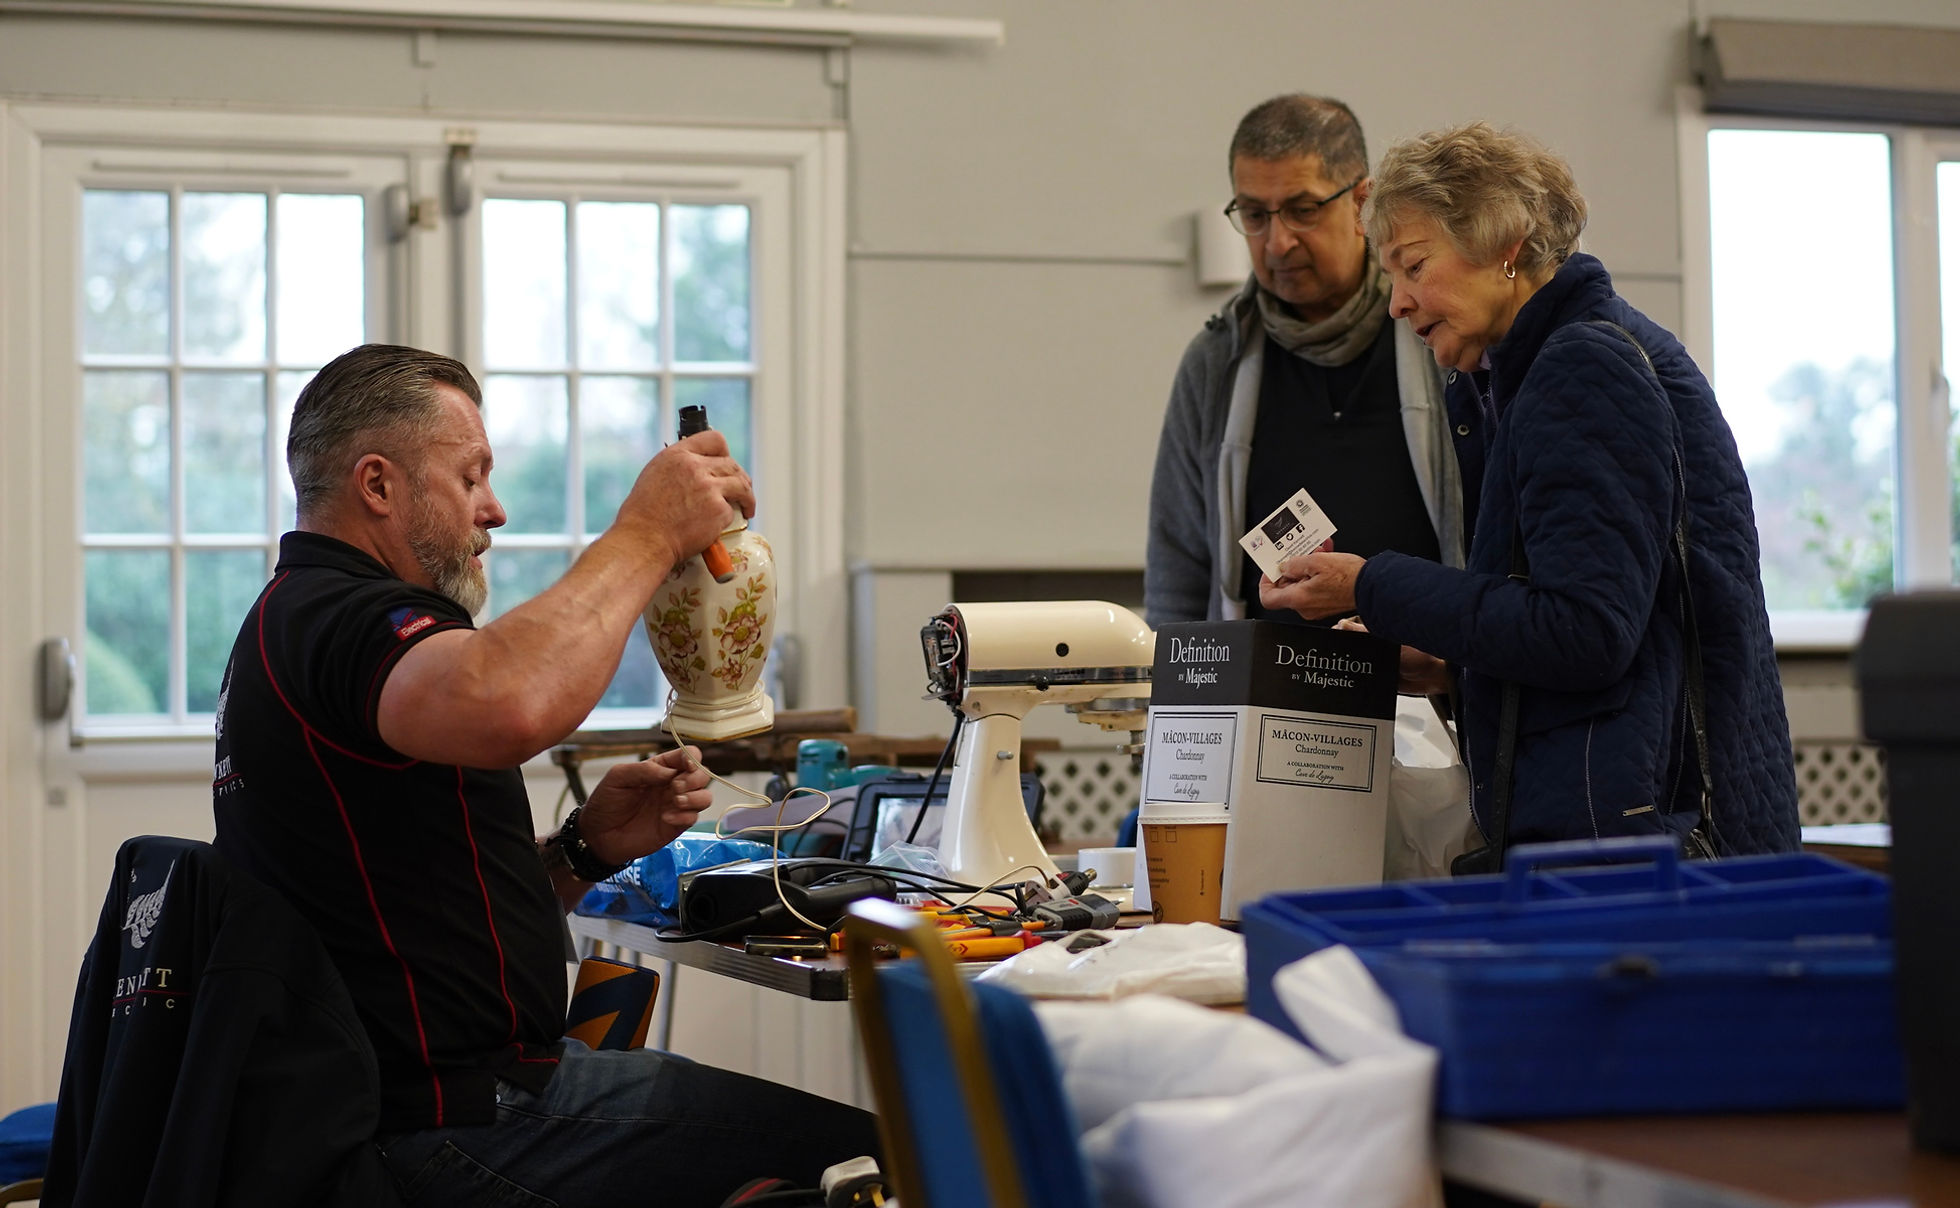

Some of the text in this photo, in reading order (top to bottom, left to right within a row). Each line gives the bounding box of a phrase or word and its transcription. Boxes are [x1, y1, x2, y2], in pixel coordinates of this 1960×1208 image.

[1169, 636, 1230, 664] Definition
[1275, 644, 1373, 674] Definition
[1178, 667, 1218, 689] BY Majestic
[1291, 671, 1354, 689] BY Majestic
[1162, 730, 1223, 745] MÂCON-VILLAGES
[1272, 729, 1363, 747] MÂCON-VILLAGES
[1175, 748, 1206, 764] Chardonnay
[1295, 744, 1339, 759] Chardonnay
[1291, 762, 1330, 770] COLLABORATION
